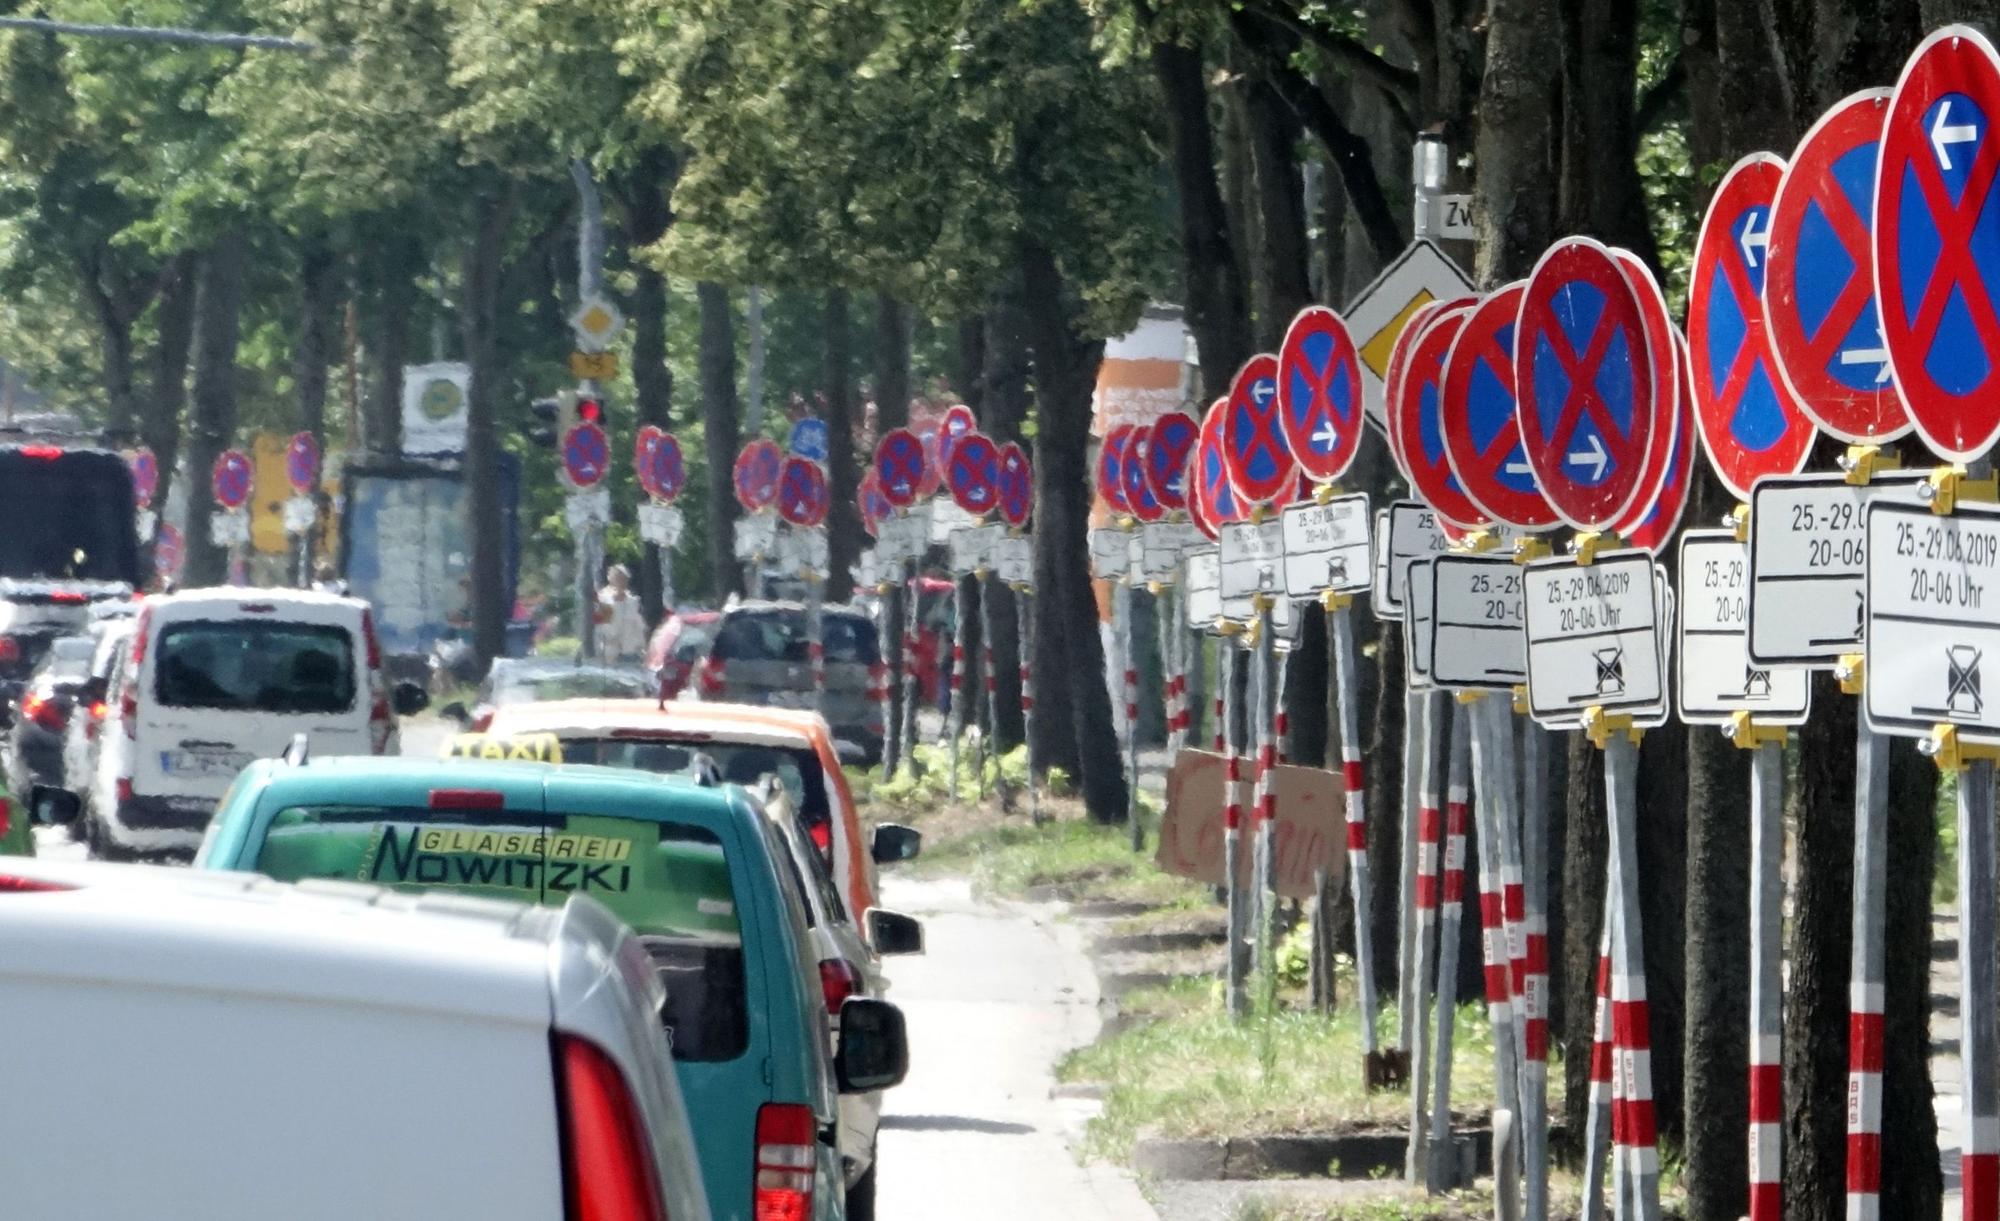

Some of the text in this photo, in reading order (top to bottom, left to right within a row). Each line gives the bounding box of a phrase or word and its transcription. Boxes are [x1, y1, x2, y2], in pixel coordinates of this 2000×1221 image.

[1808, 538, 1865, 567] 20-06
[1896, 521, 1998, 568] 25.-29.06.2019
[1546, 571, 1630, 604] 25.-29.06.2019
[1910, 567, 1984, 609] 20-06 Uhr
[1560, 602, 1622, 632] 20-06 Uhr
[1715, 595, 1746, 622] 20-0
[452, 733, 546, 762] TAXI
[371, 823, 631, 892] NOWITZKI
[423, 831, 623, 858] GLASEREI
